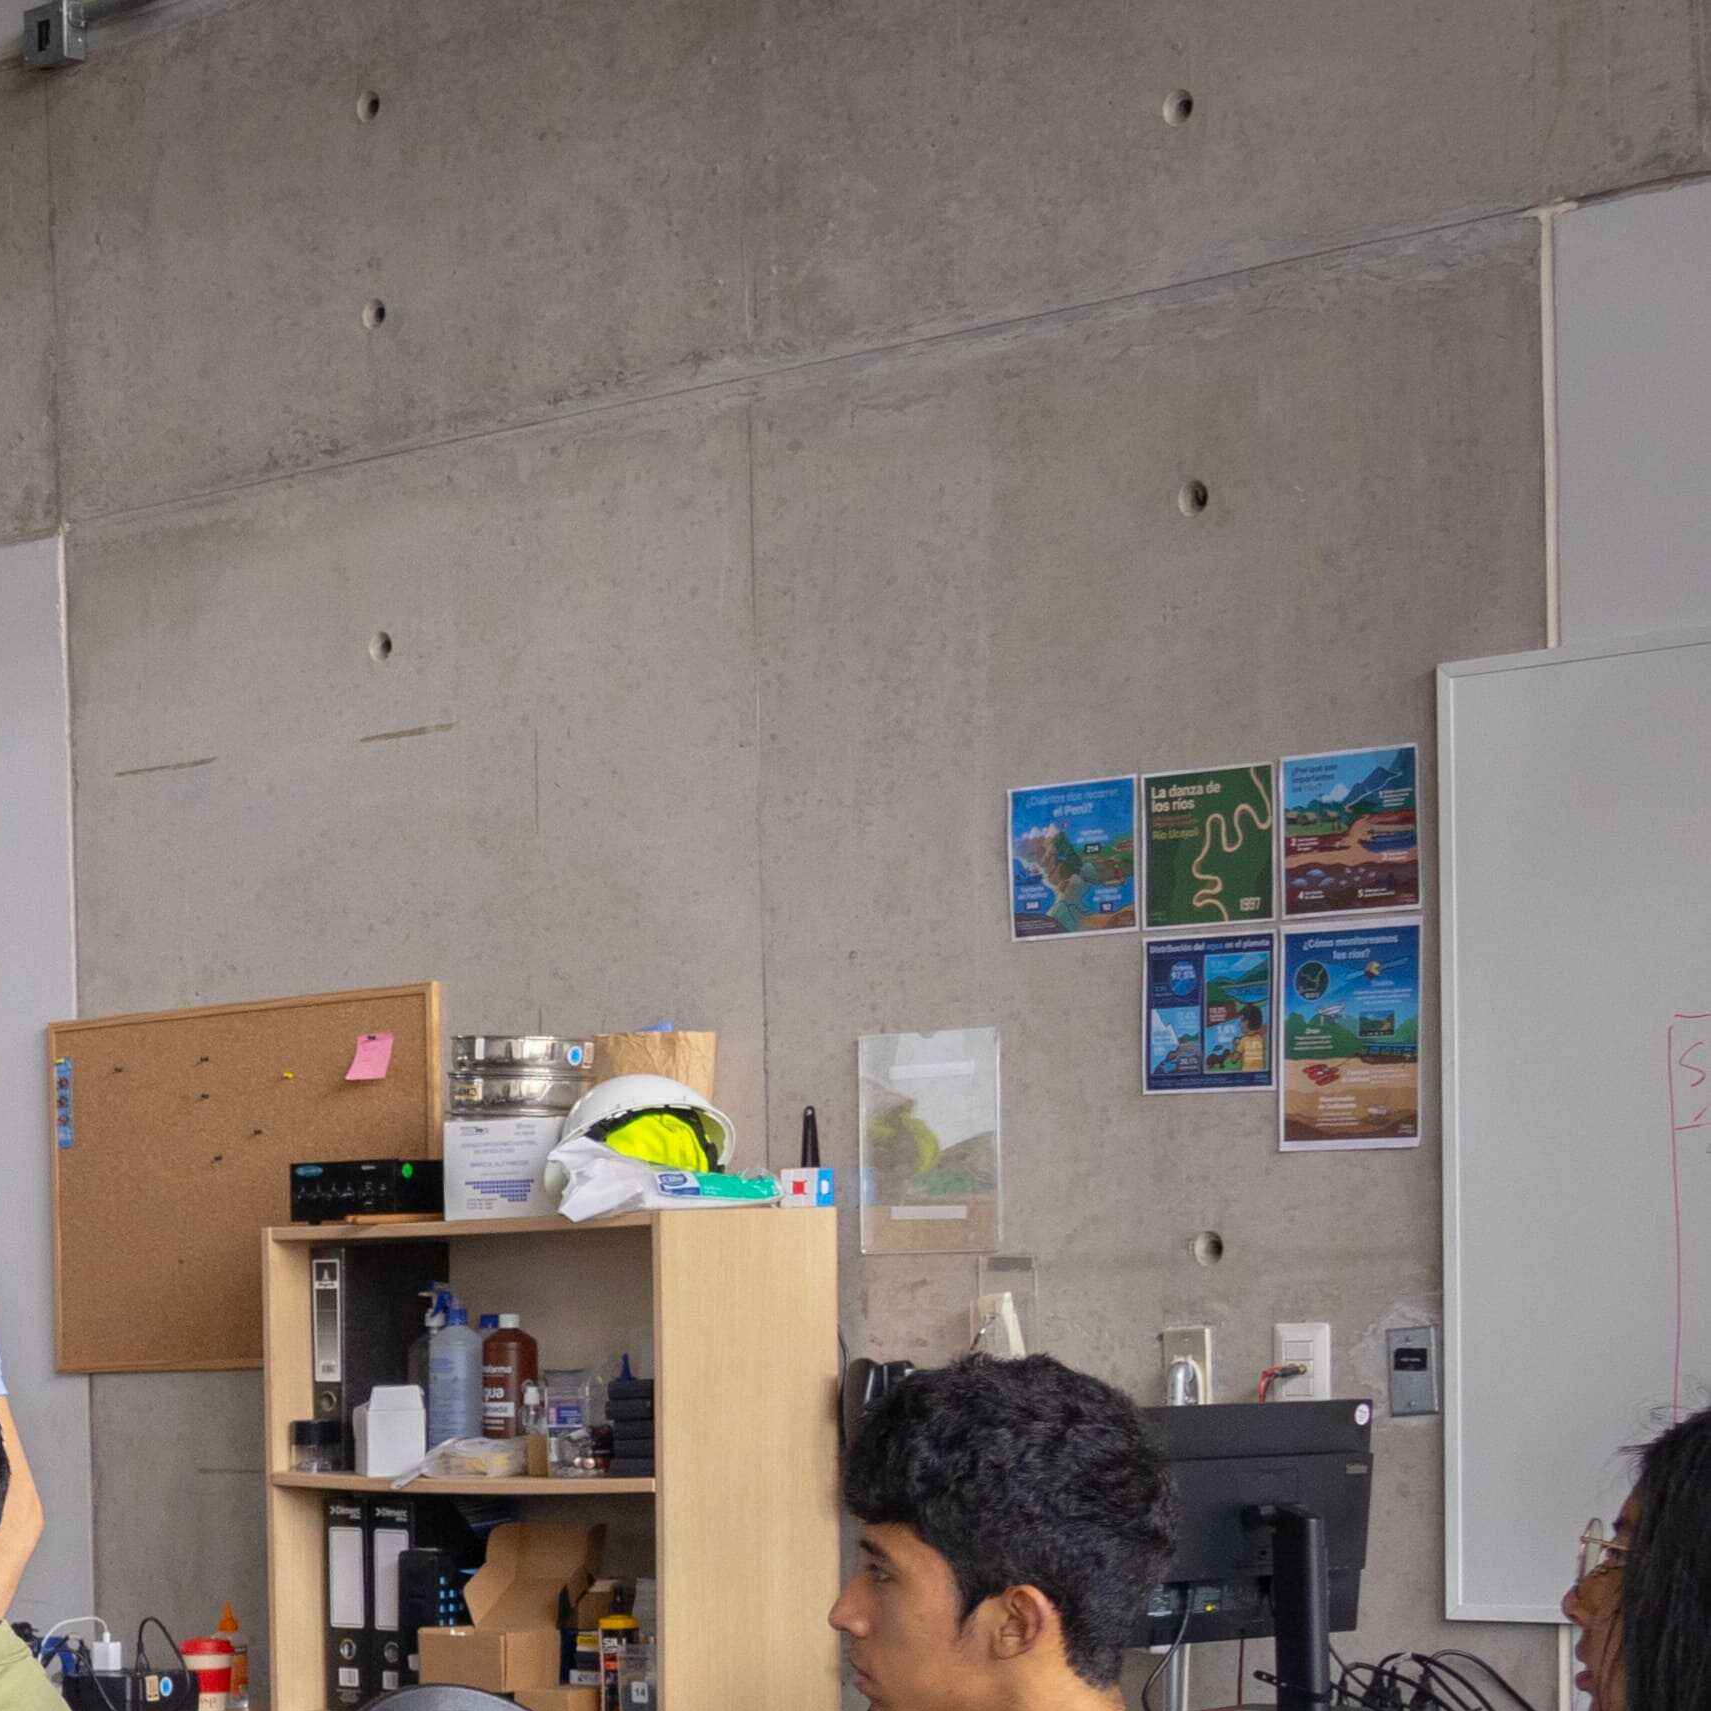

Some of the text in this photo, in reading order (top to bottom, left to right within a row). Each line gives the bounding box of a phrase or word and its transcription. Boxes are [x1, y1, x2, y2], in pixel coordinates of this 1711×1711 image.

[1151, 780, 1221, 800] La danza de
[1151, 797, 1195, 813] los ríos
[1303, 936, 1334, 950] ¿Cómo
[1333, 949, 1347, 960] los
